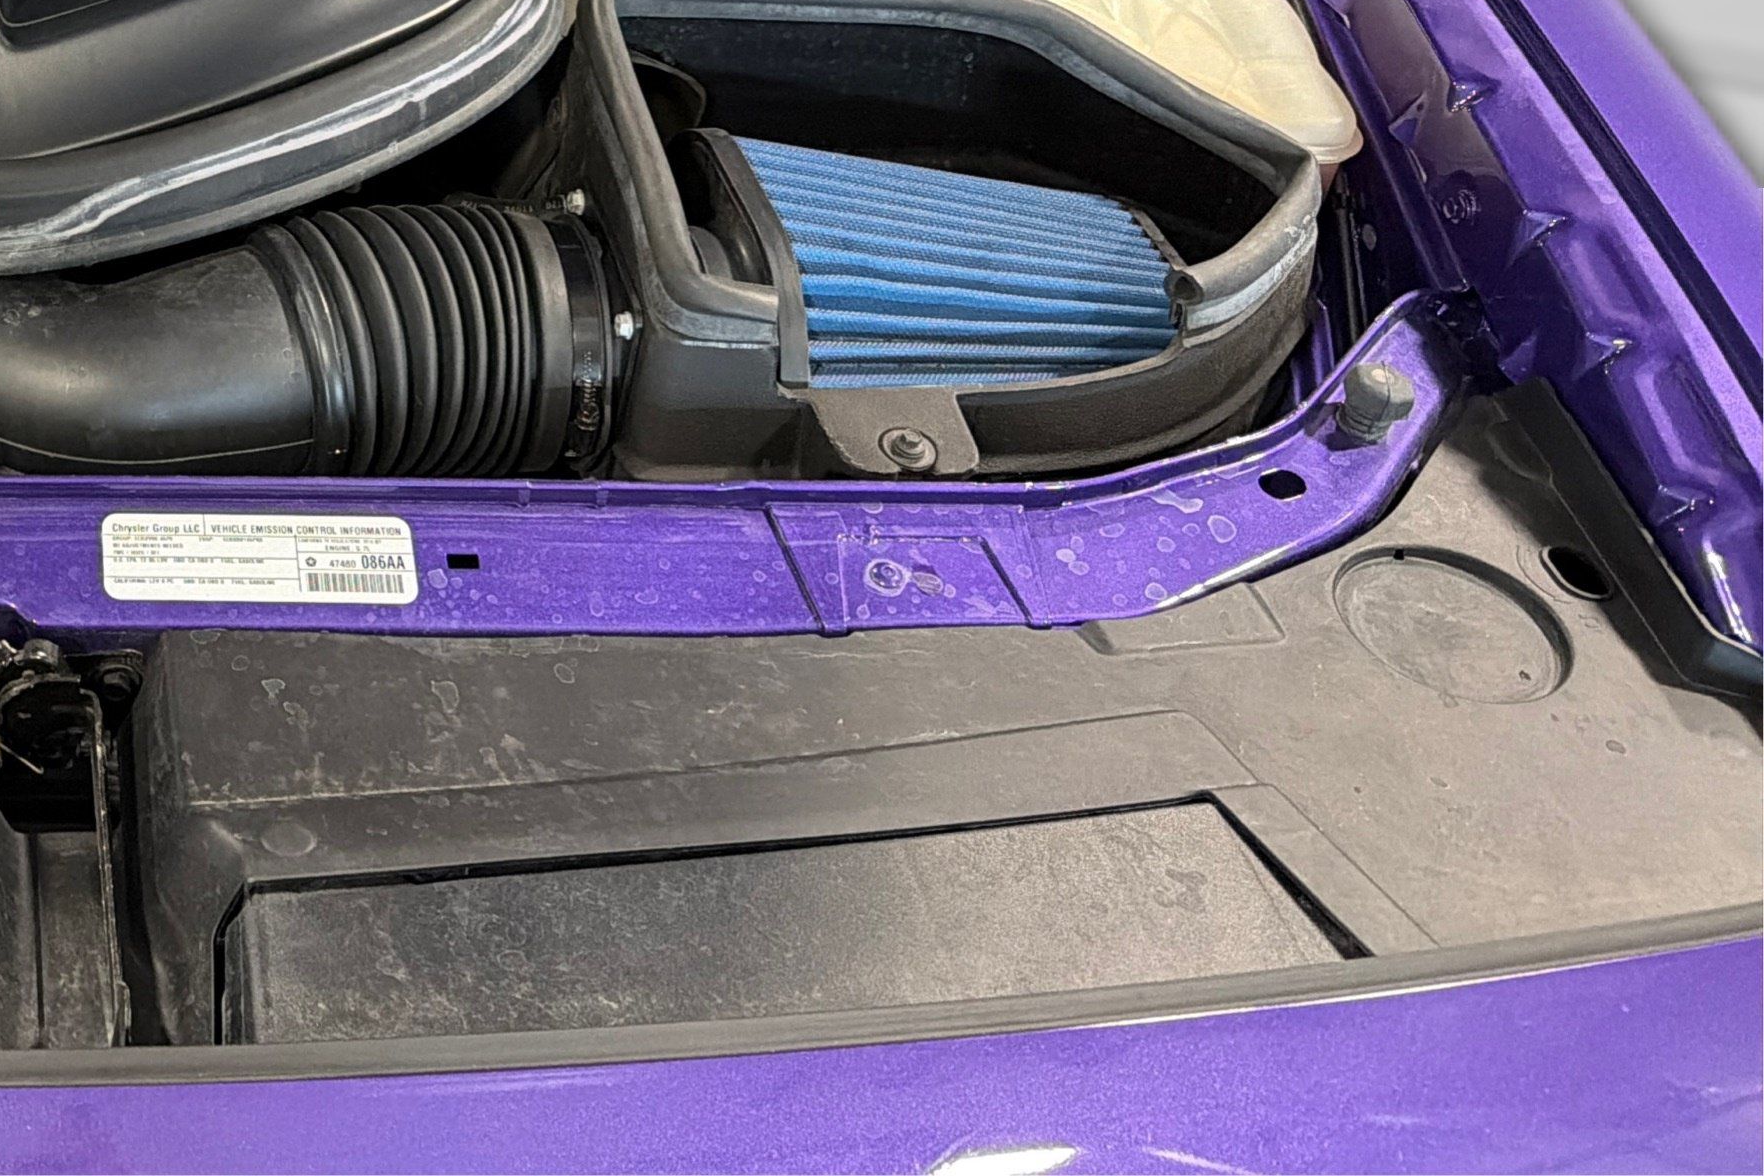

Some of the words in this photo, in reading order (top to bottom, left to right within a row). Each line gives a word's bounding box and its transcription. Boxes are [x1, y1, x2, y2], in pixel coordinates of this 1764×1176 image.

[112, 523, 149, 535] Chrysler
[152, 524, 180, 534] Group
[183, 524, 200, 533] LLC
[211, 525, 247, 534] VEHICLE
[250, 525, 293, 534] EMISSION
[296, 526, 337, 535] CONTROL
[340, 526, 401, 536] INFORMATION
[361, 555, 406, 570] 086AA
